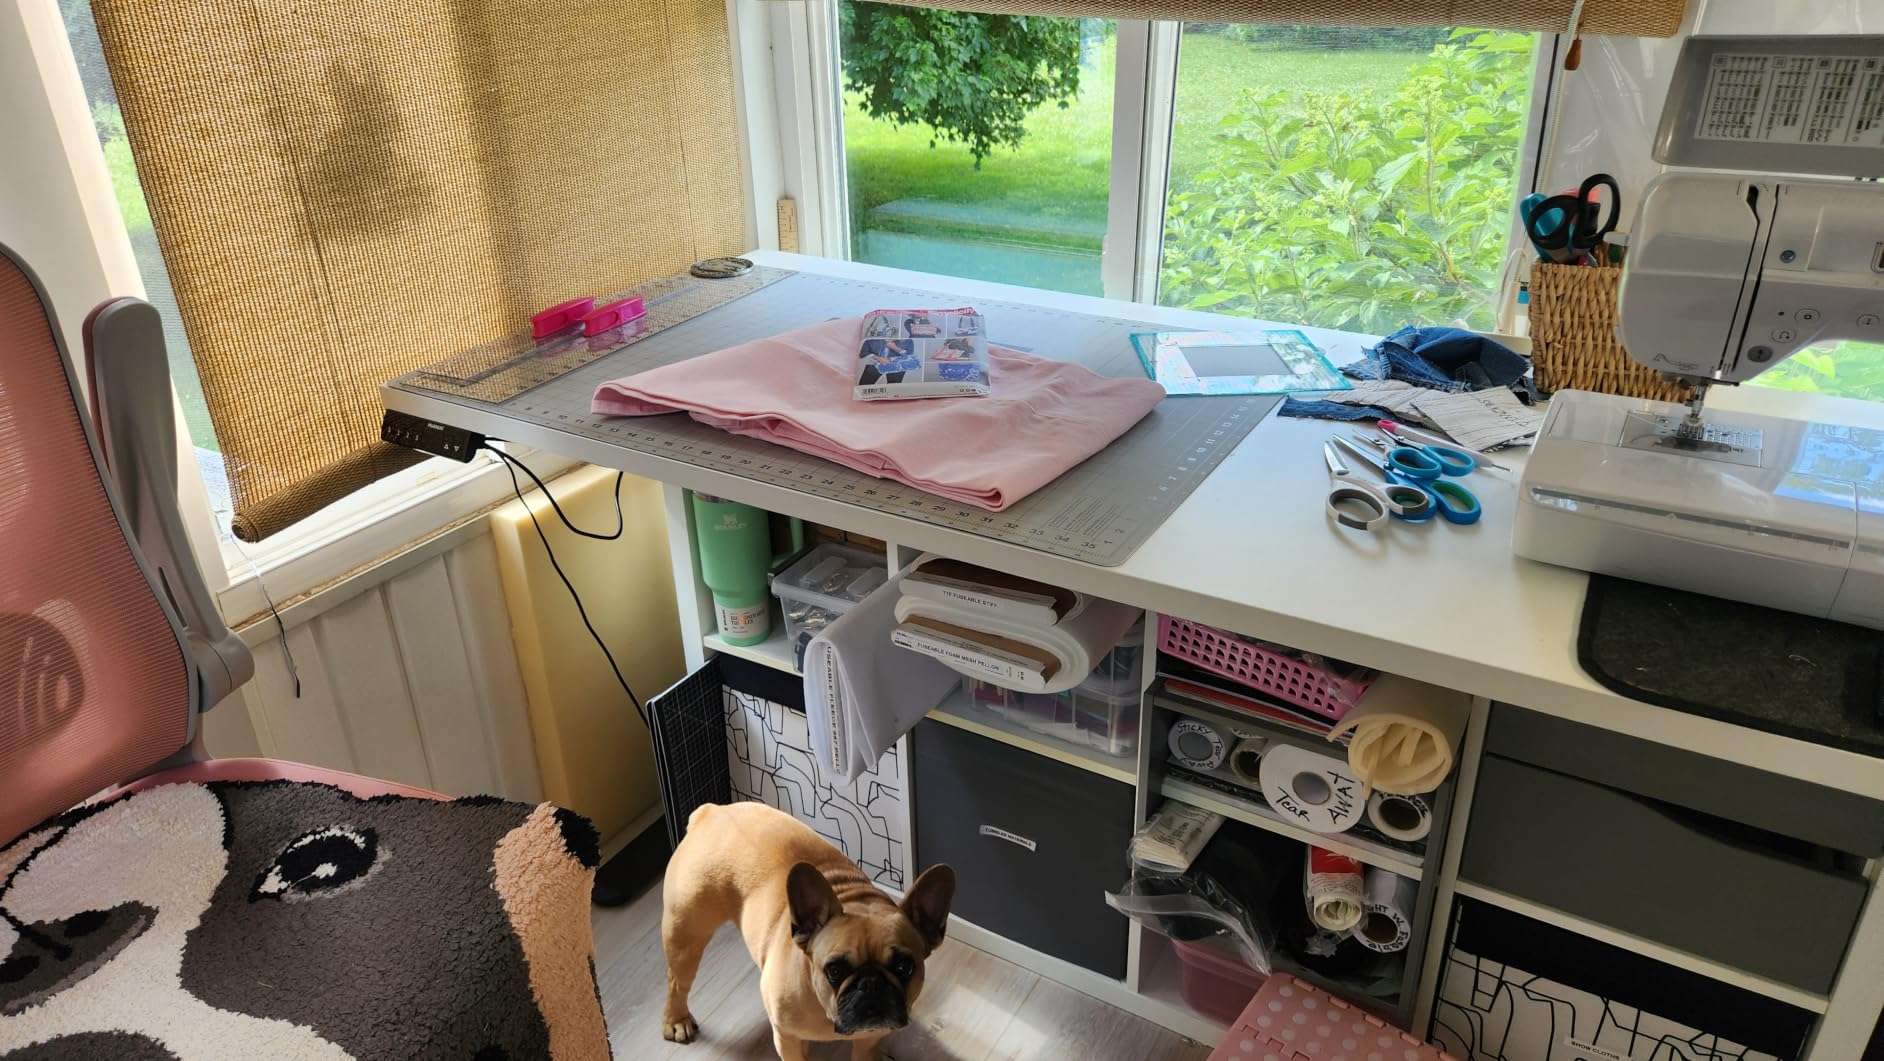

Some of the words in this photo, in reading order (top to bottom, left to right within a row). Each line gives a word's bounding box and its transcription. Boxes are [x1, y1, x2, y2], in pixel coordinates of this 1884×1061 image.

[1004, 522, 1019, 530] 32
[1029, 528, 1044, 536] 33
[1055, 535, 1070, 543] 34
[1081, 541, 1096, 549] 35
[917, 642, 945, 655] FUSEABLE
[945, 650, 961, 659] FOAM
[961, 655, 977, 664] MESH
[977, 659, 1000, 671] PELLON
[1571, 1041, 1591, 1050] SHOW
[1592, 1048, 1620, 1060] CLOTHS
